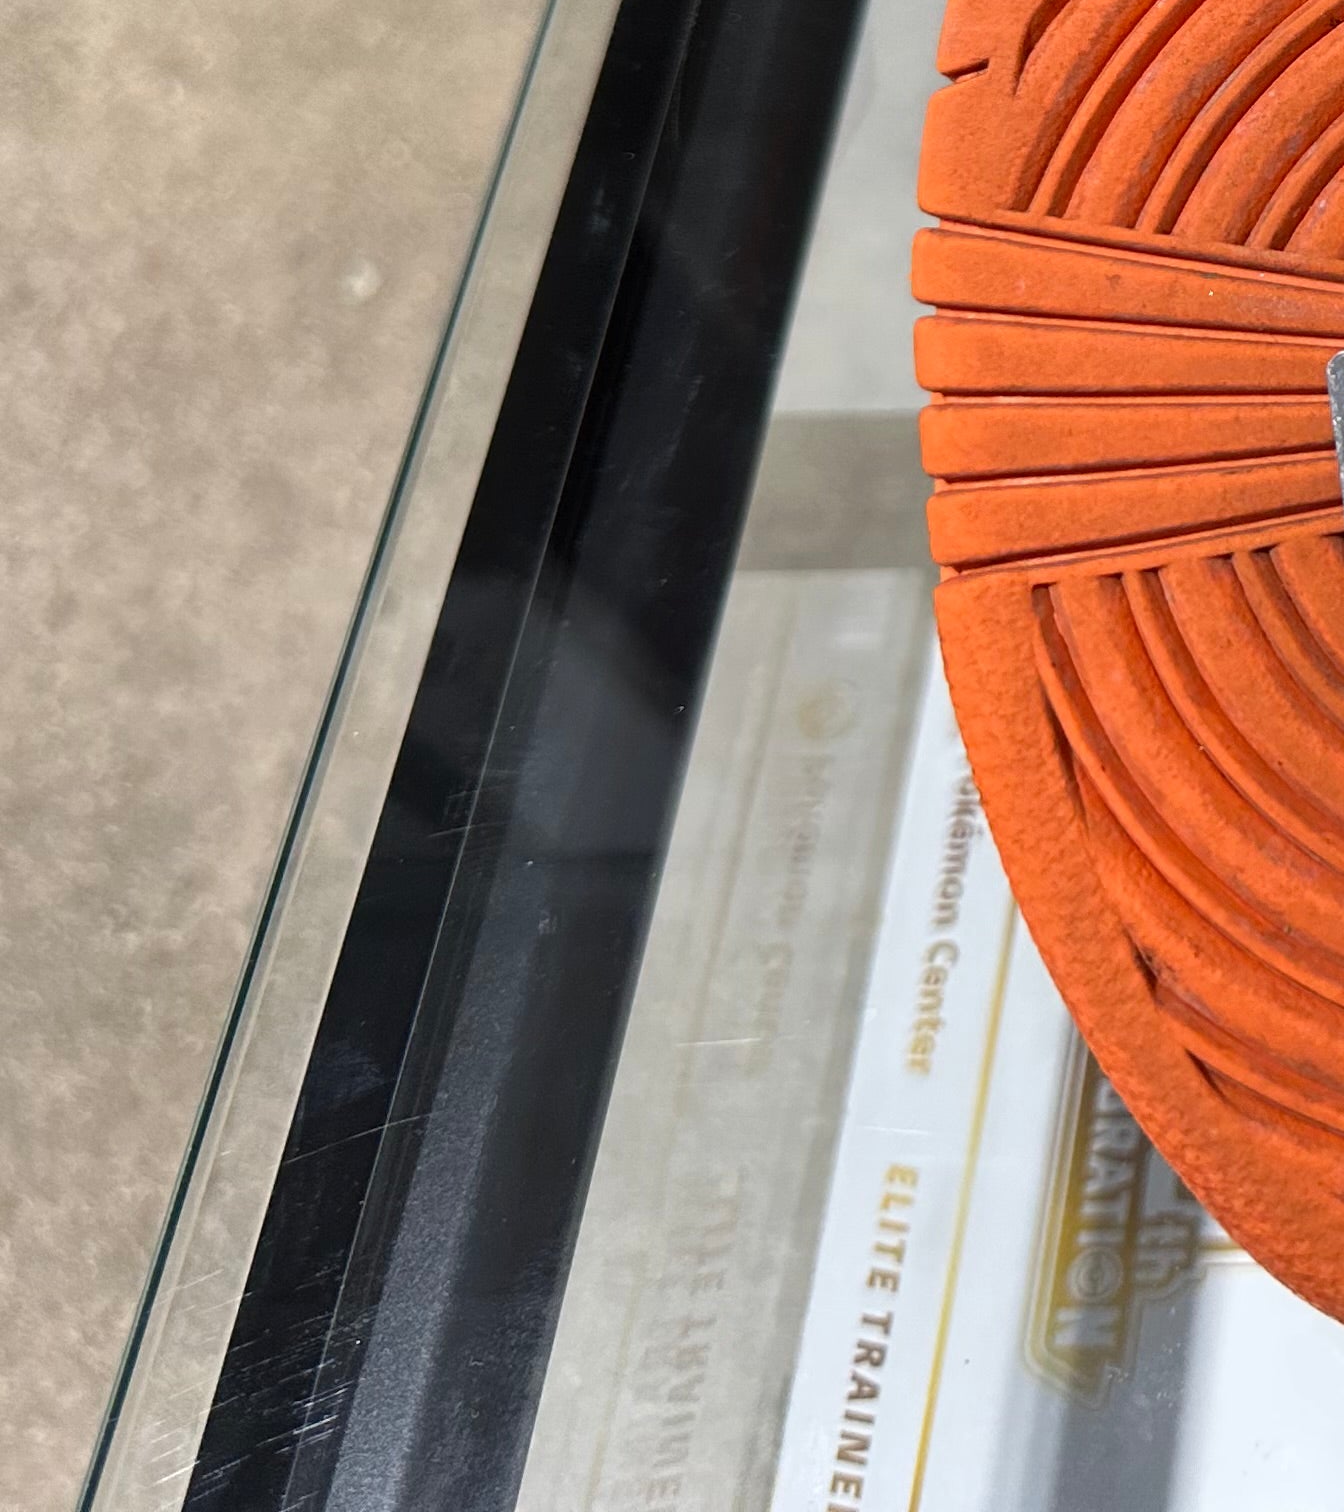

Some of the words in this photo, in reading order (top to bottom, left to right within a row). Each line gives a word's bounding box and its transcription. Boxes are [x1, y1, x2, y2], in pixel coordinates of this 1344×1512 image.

[930, 774, 985, 931] okémon
[905, 937, 960, 1078] Center
[866, 1163, 920, 1294] ELITE
[825, 1310, 894, 1512] TRAINE
